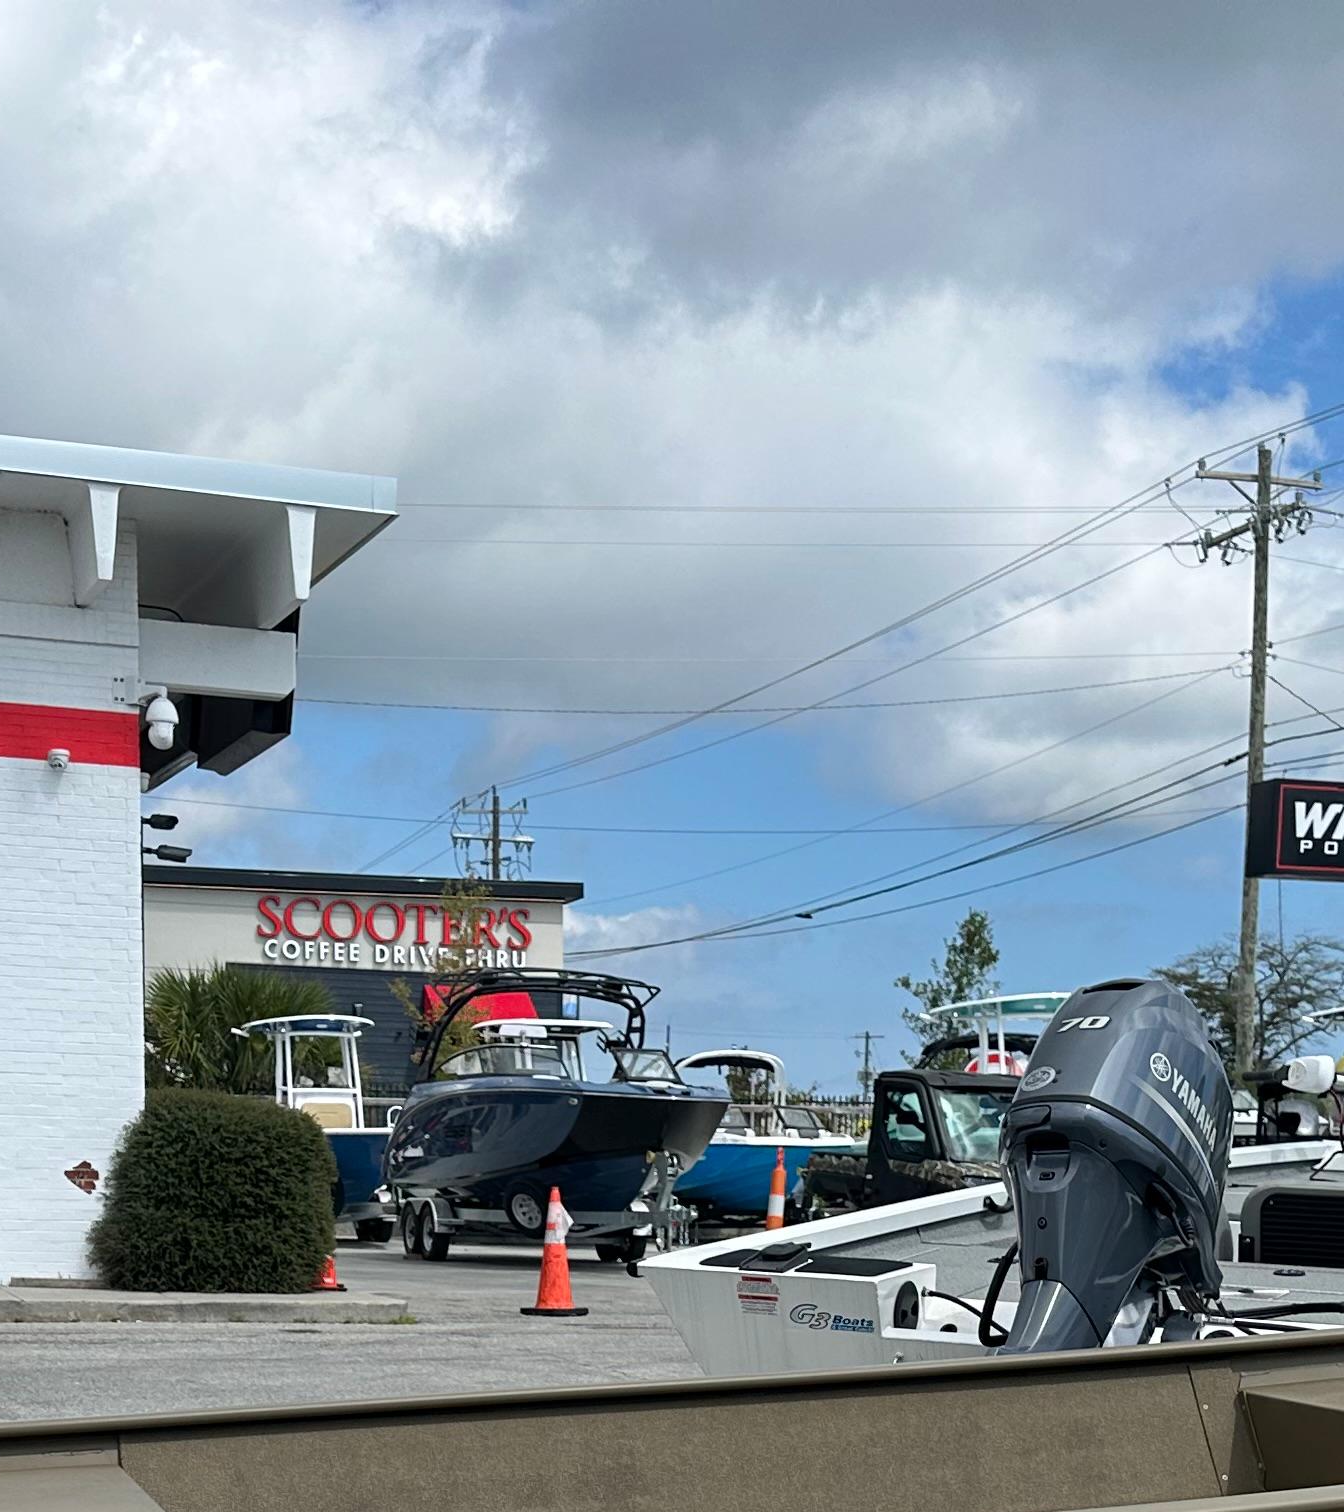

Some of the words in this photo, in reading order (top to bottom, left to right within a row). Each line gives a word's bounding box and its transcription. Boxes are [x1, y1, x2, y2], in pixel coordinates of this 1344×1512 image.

[256, 895, 533, 950] SCOOTER'S
[263, 939, 360, 963] COFFEE
[1056, 1015, 1111, 1033] 70
[1170, 1067, 1217, 1153] YAMAHA
[789, 1303, 832, 1330] G3
[832, 1314, 874, 1327] Boats
